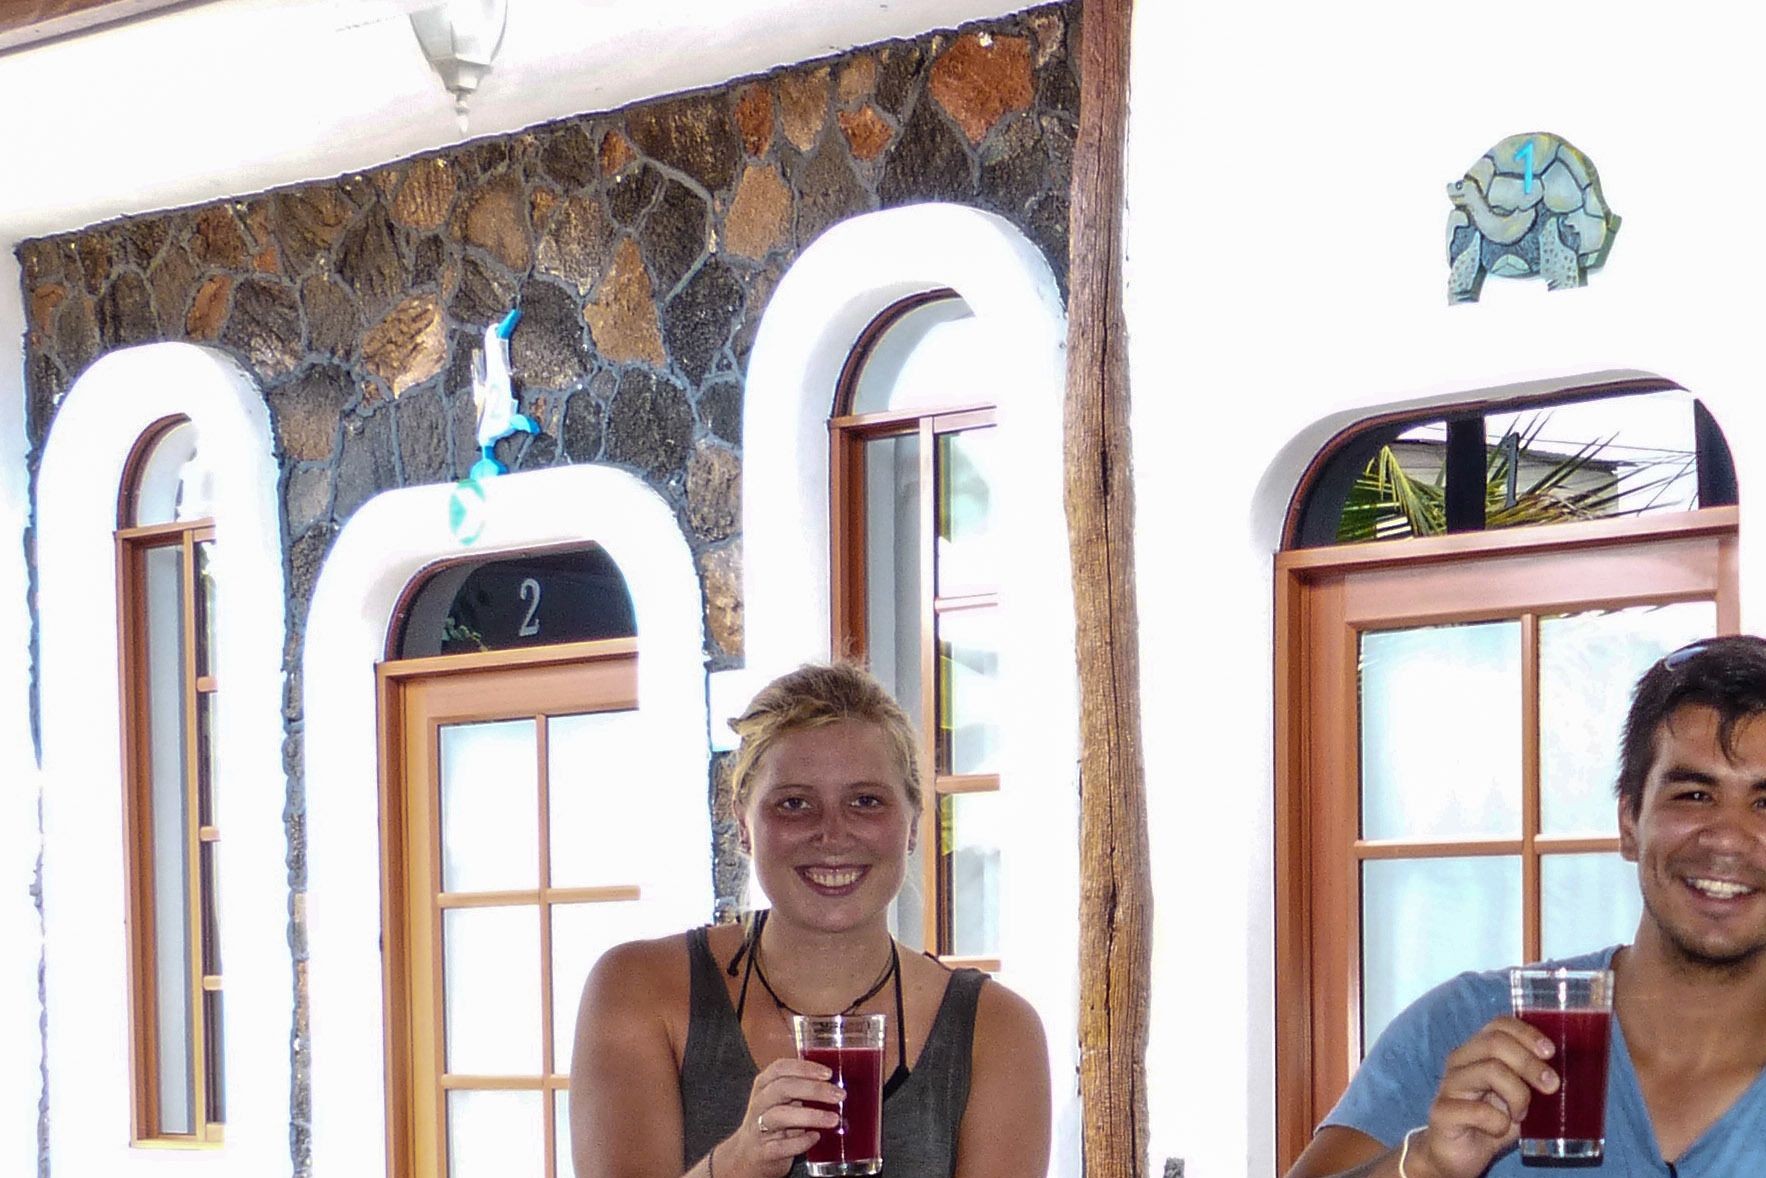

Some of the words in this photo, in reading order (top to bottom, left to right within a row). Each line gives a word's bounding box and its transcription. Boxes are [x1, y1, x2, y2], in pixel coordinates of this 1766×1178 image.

[1514, 139, 1533, 195] 1
[1500, 431, 1519, 508] 1
[518, 578, 540, 637] 2
